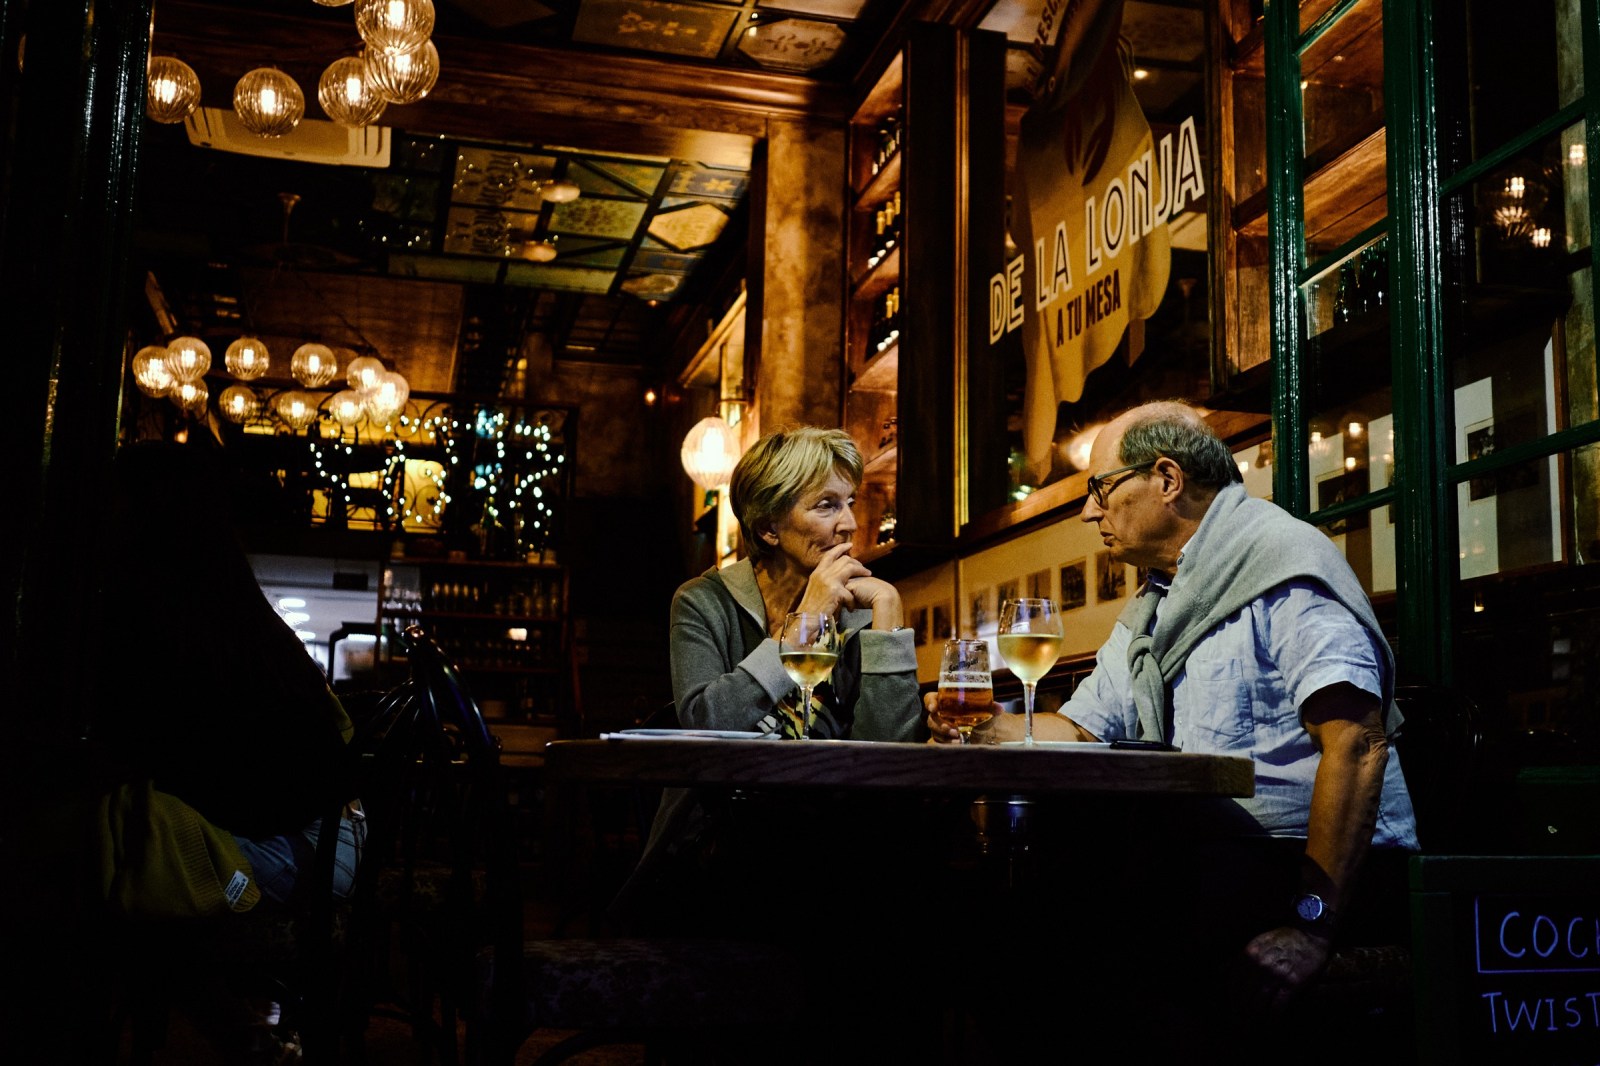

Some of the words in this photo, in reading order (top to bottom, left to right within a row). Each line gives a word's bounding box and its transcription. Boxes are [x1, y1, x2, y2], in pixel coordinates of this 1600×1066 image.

[1034, 0, 1062, 62] PESC
[990, 253, 1024, 346] DE
[1036, 220, 1073, 312] LA
[1085, 115, 1205, 276] LONJA
[1057, 308, 1064, 348] A
[1067, 295, 1081, 340] TU
[1085, 269, 1120, 329] MESA
[1500, 911, 1600, 958] COC
[1481, 991, 1600, 1033] TWIST
